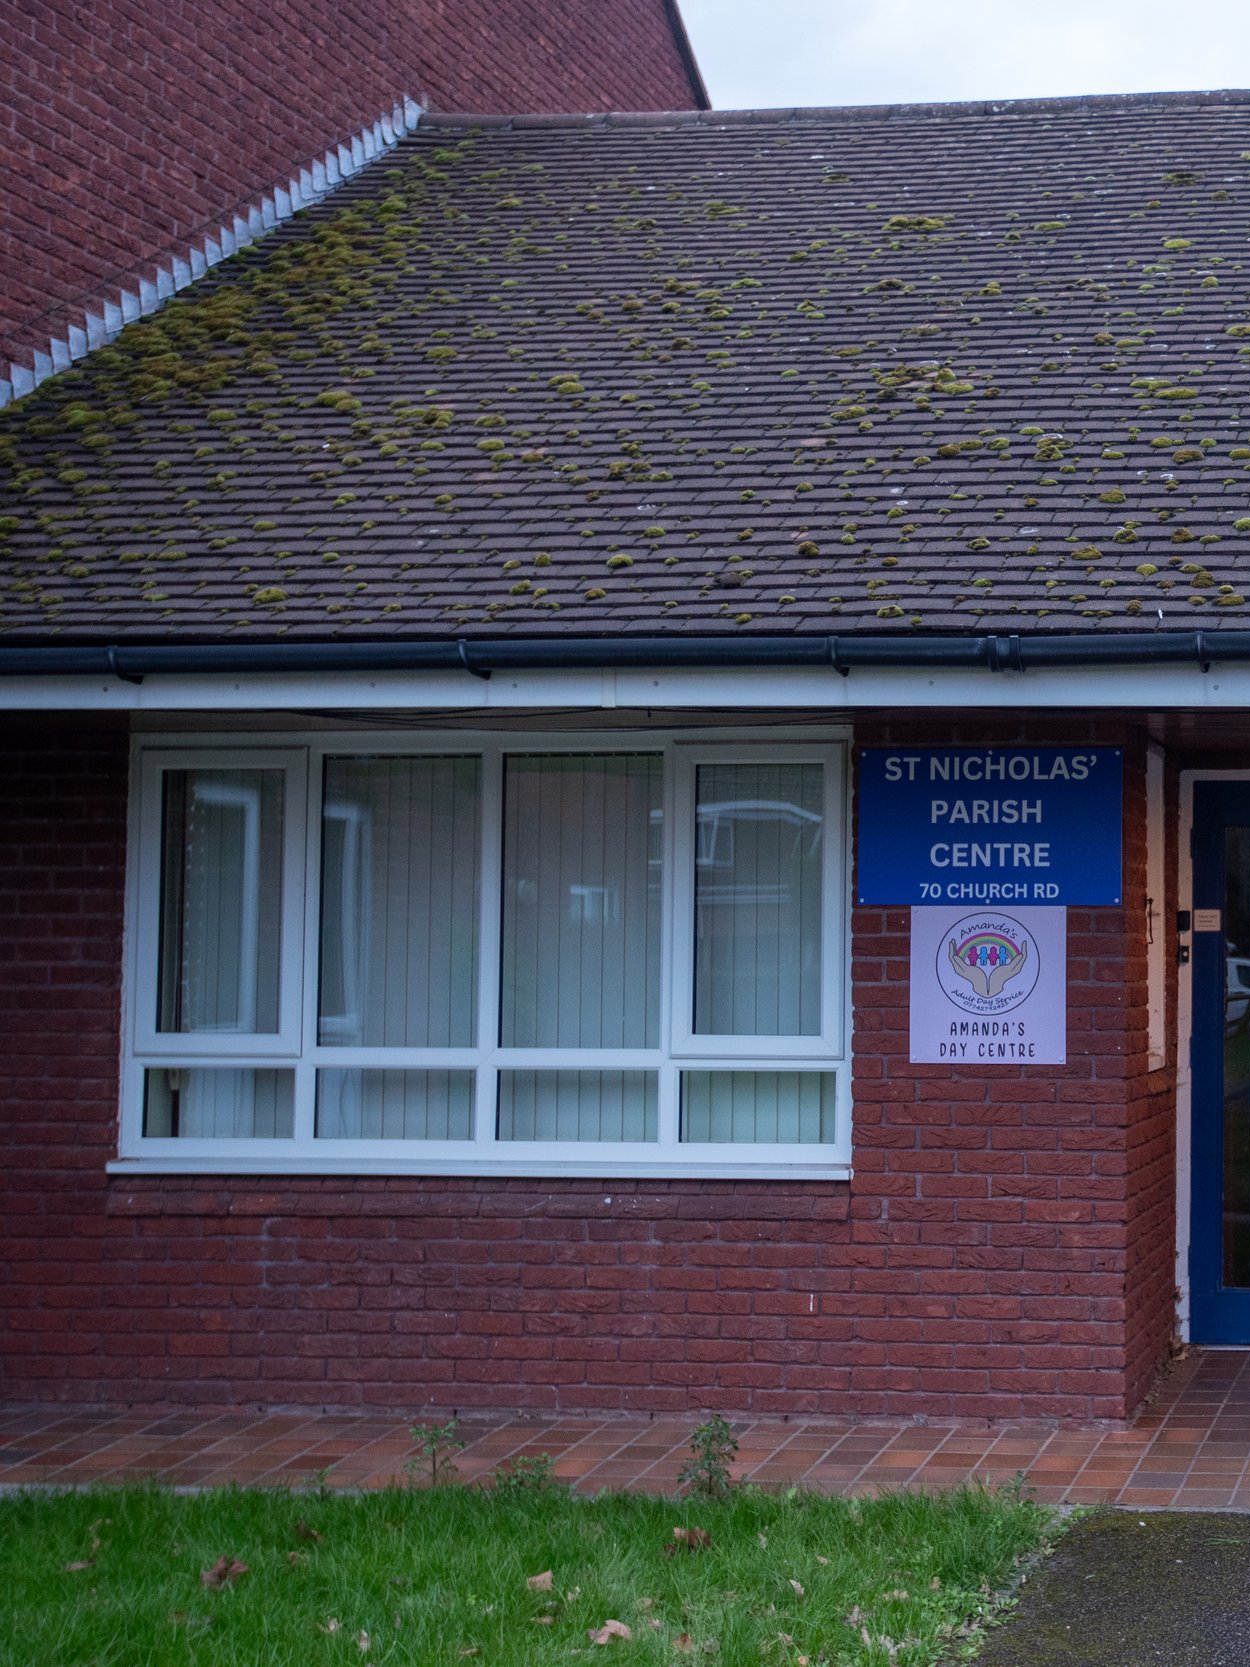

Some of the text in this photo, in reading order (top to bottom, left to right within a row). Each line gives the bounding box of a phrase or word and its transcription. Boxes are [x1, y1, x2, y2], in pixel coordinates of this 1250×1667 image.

[884, 755, 1097, 781] ST NICHOLAS'
[930, 799, 1042, 824] PARISH
[929, 843, 1051, 867] CENTRE
[919, 883, 1060, 898] 70 CHURCH RD
[960, 922, 1018, 940] Amanda's
[950, 989, 1024, 1006] Adult Day Service
[950, 1021, 1025, 1037] AMANDA'S
[940, 1042, 1036, 1057] DAY CENTRE
